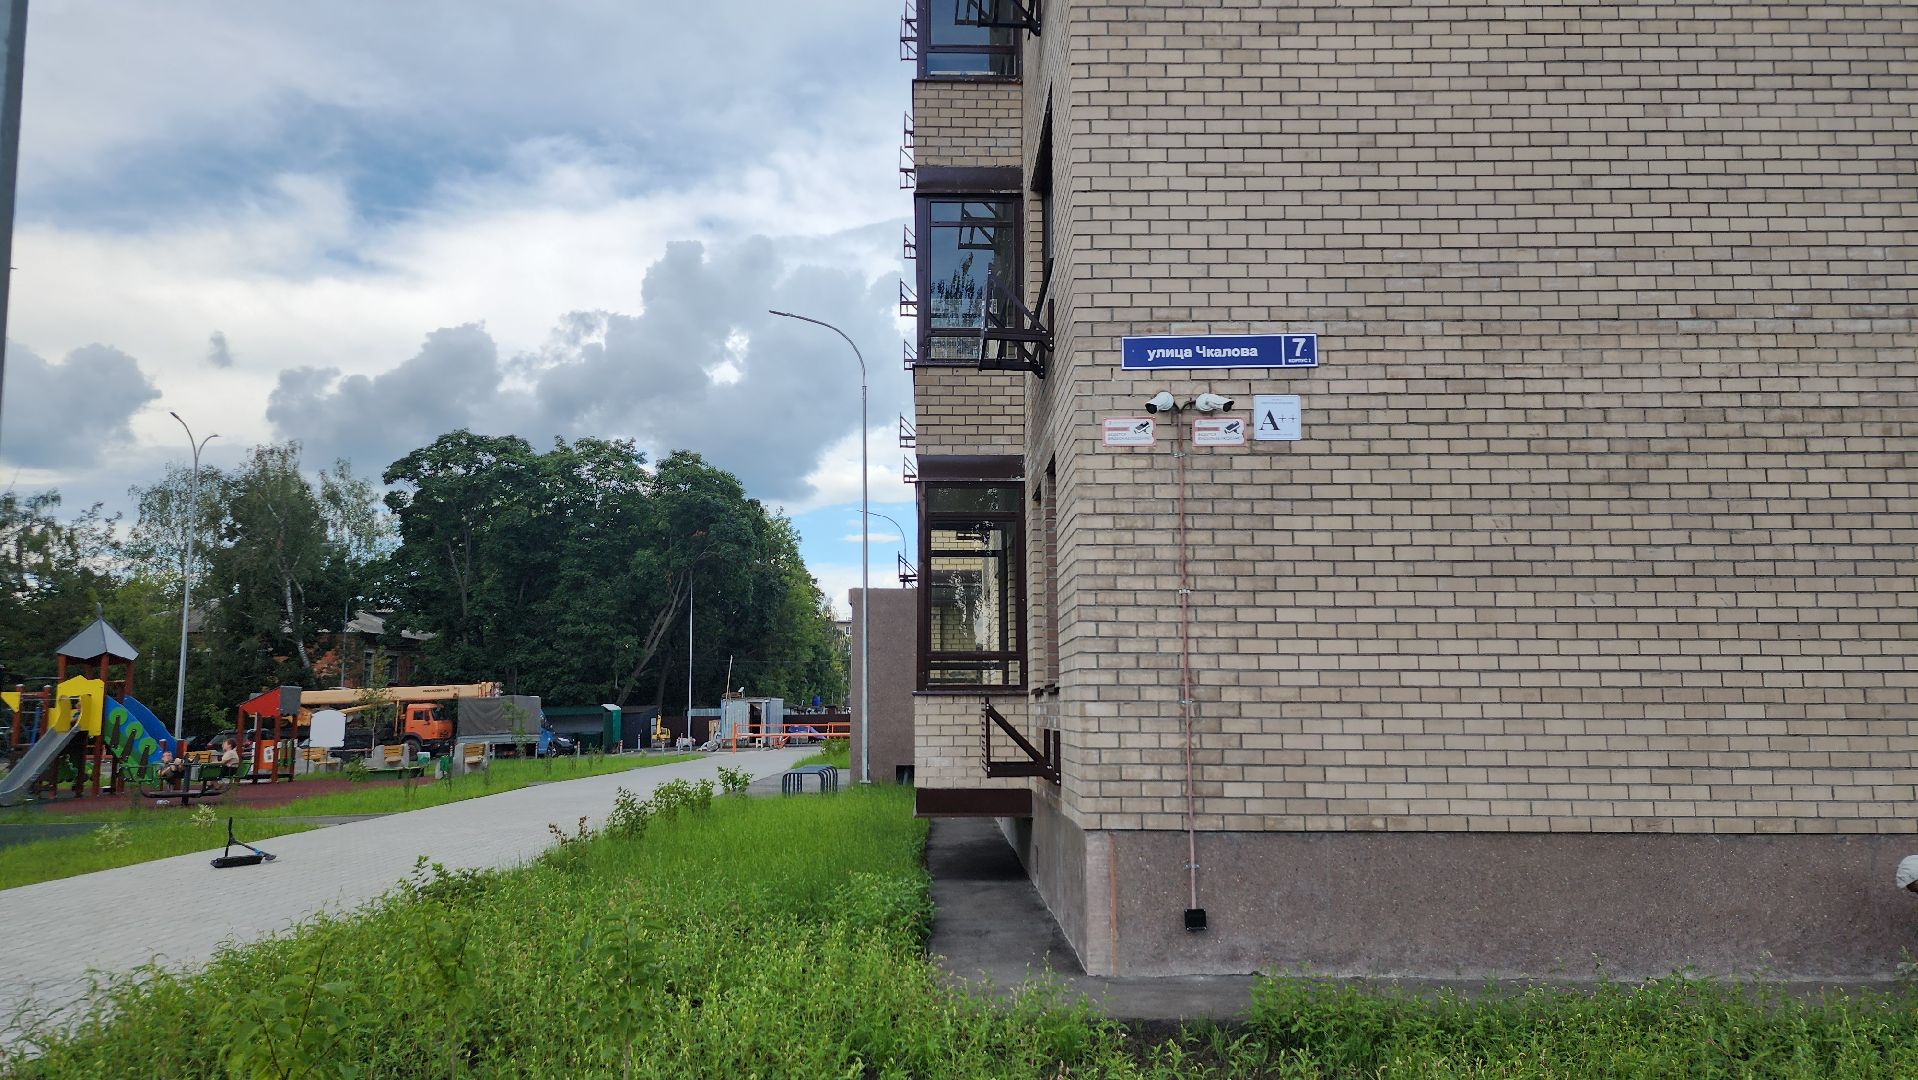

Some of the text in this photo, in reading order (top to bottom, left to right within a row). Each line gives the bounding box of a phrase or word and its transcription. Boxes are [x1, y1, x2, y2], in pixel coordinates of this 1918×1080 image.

[1147, 345, 1258, 361] улица Чкалова
[1292, 337, 1306, 357] 7
